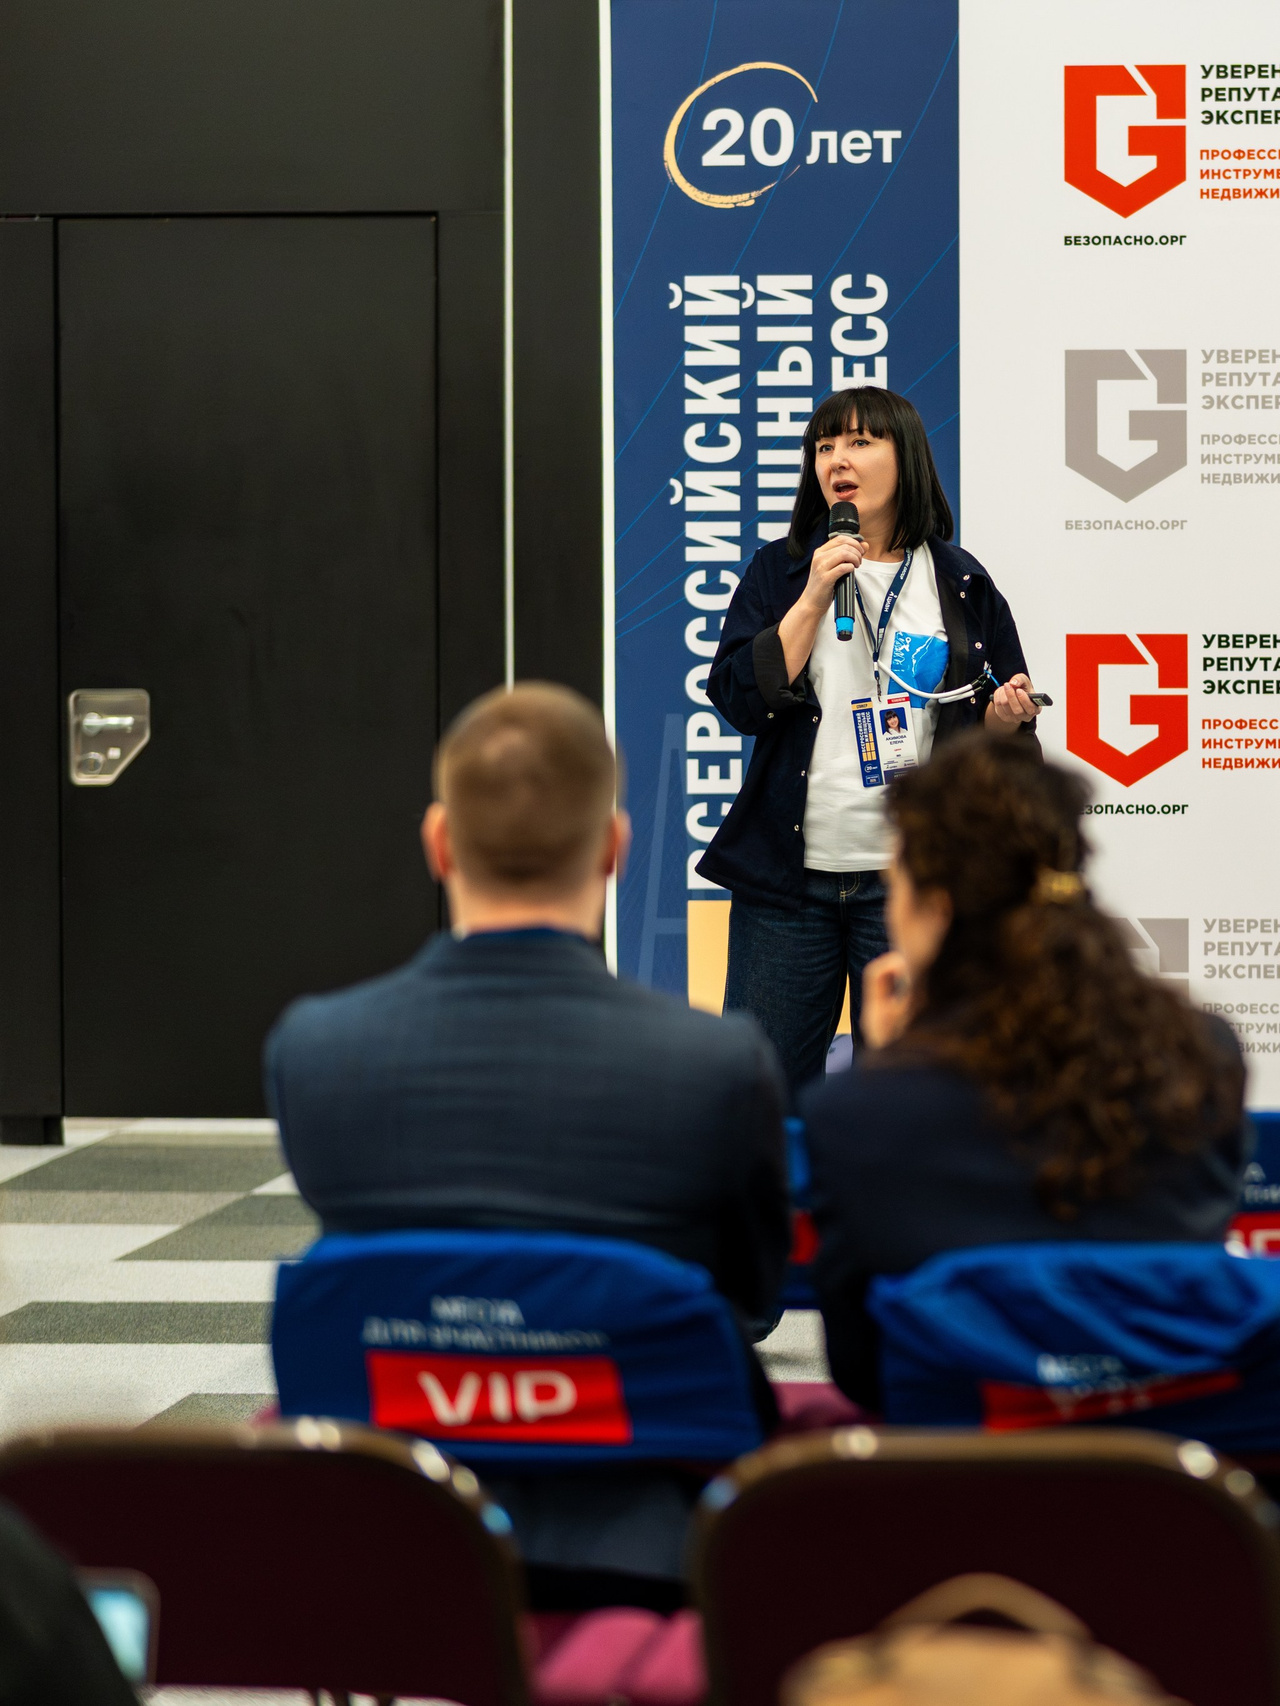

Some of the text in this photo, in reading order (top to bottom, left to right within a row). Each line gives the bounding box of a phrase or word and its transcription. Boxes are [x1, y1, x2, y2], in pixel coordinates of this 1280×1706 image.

[702, 108, 901, 166] 20 лет
[1064, 235, 1186, 245] БЕЗОПАСНО.ОРГ
[1065, 520, 1187, 530] БЕЗОПАСНО.ОРГ
[1084, 804, 1188, 814] ЗОПАСНО.ОРГ
[417, 1370, 577, 1426] VIP
